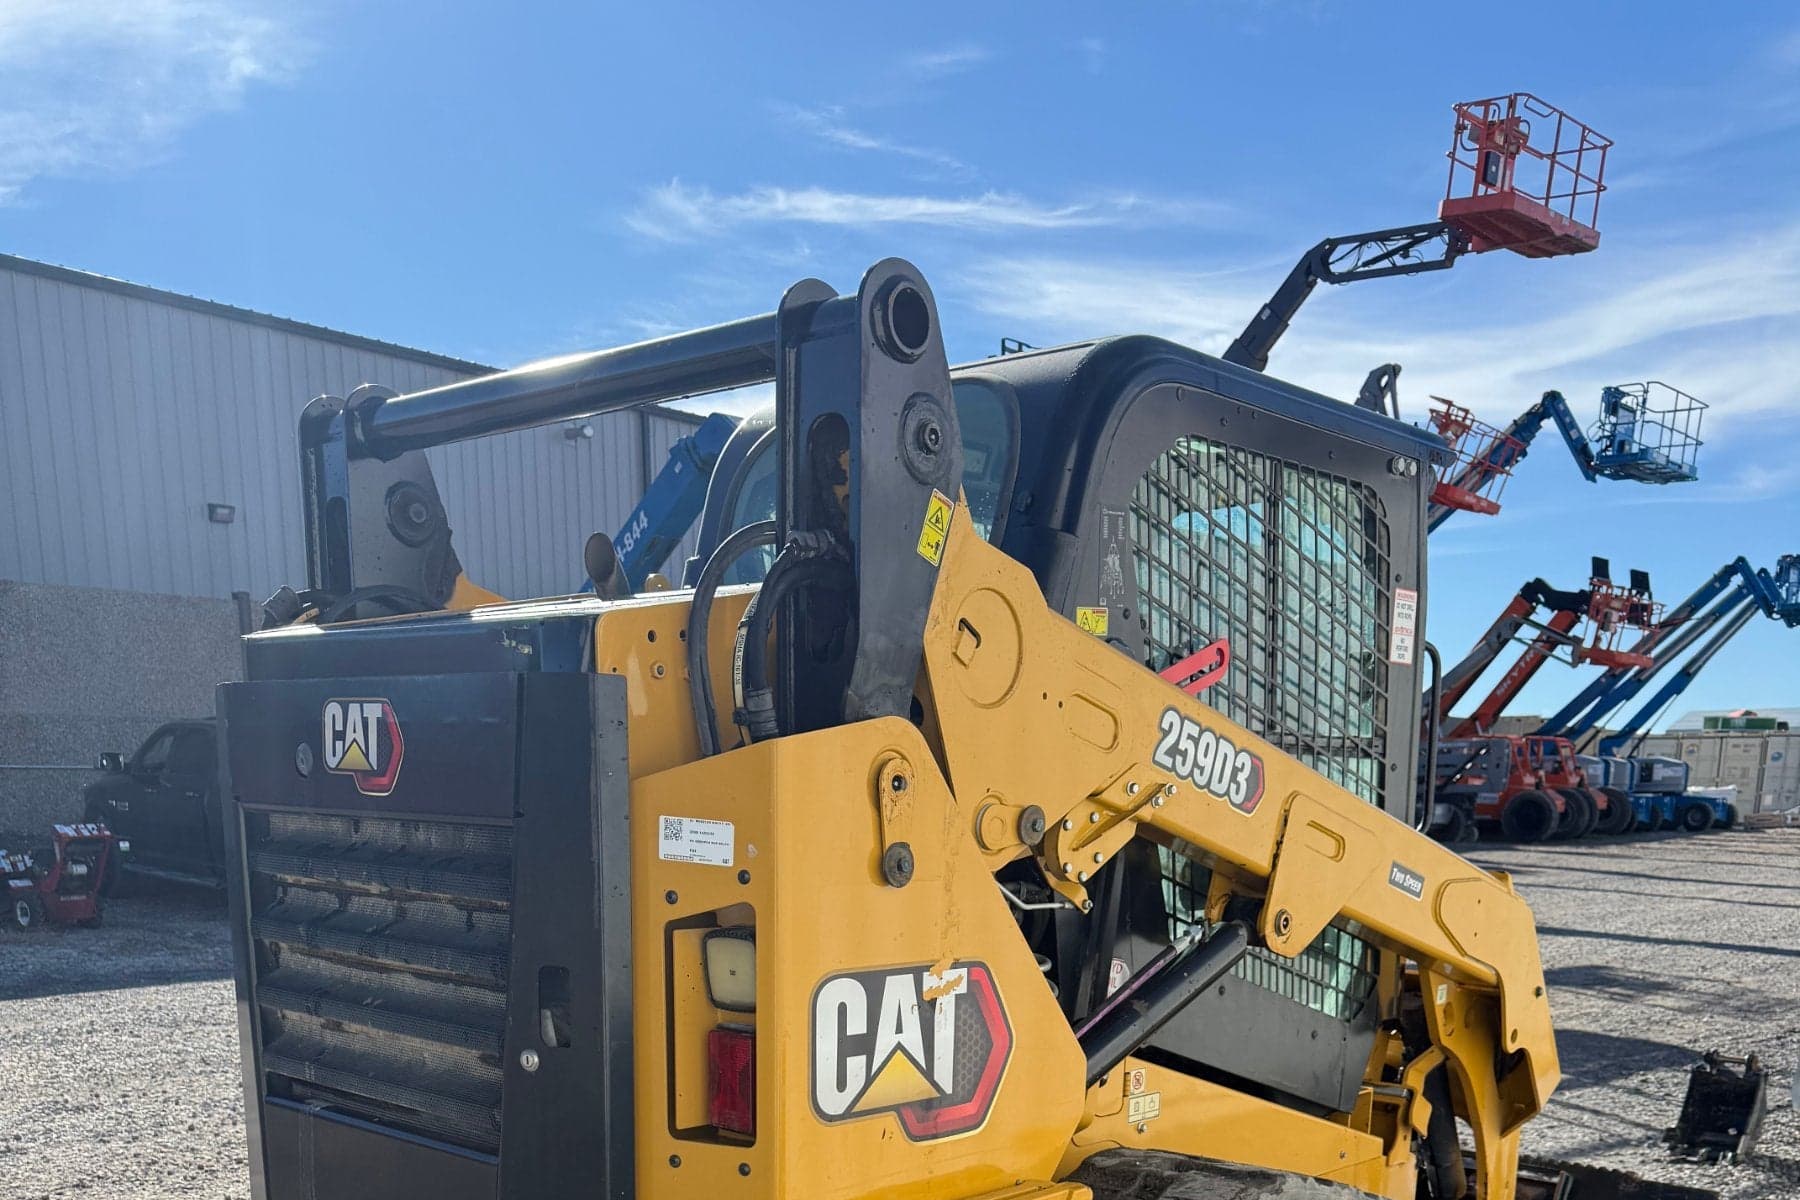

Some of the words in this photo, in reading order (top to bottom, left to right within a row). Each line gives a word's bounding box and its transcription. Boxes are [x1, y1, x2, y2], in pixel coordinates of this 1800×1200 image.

[324, 702, 382, 770] CAT
[1154, 710, 1252, 804] 259D3
[816, 968, 968, 1115] CAT
